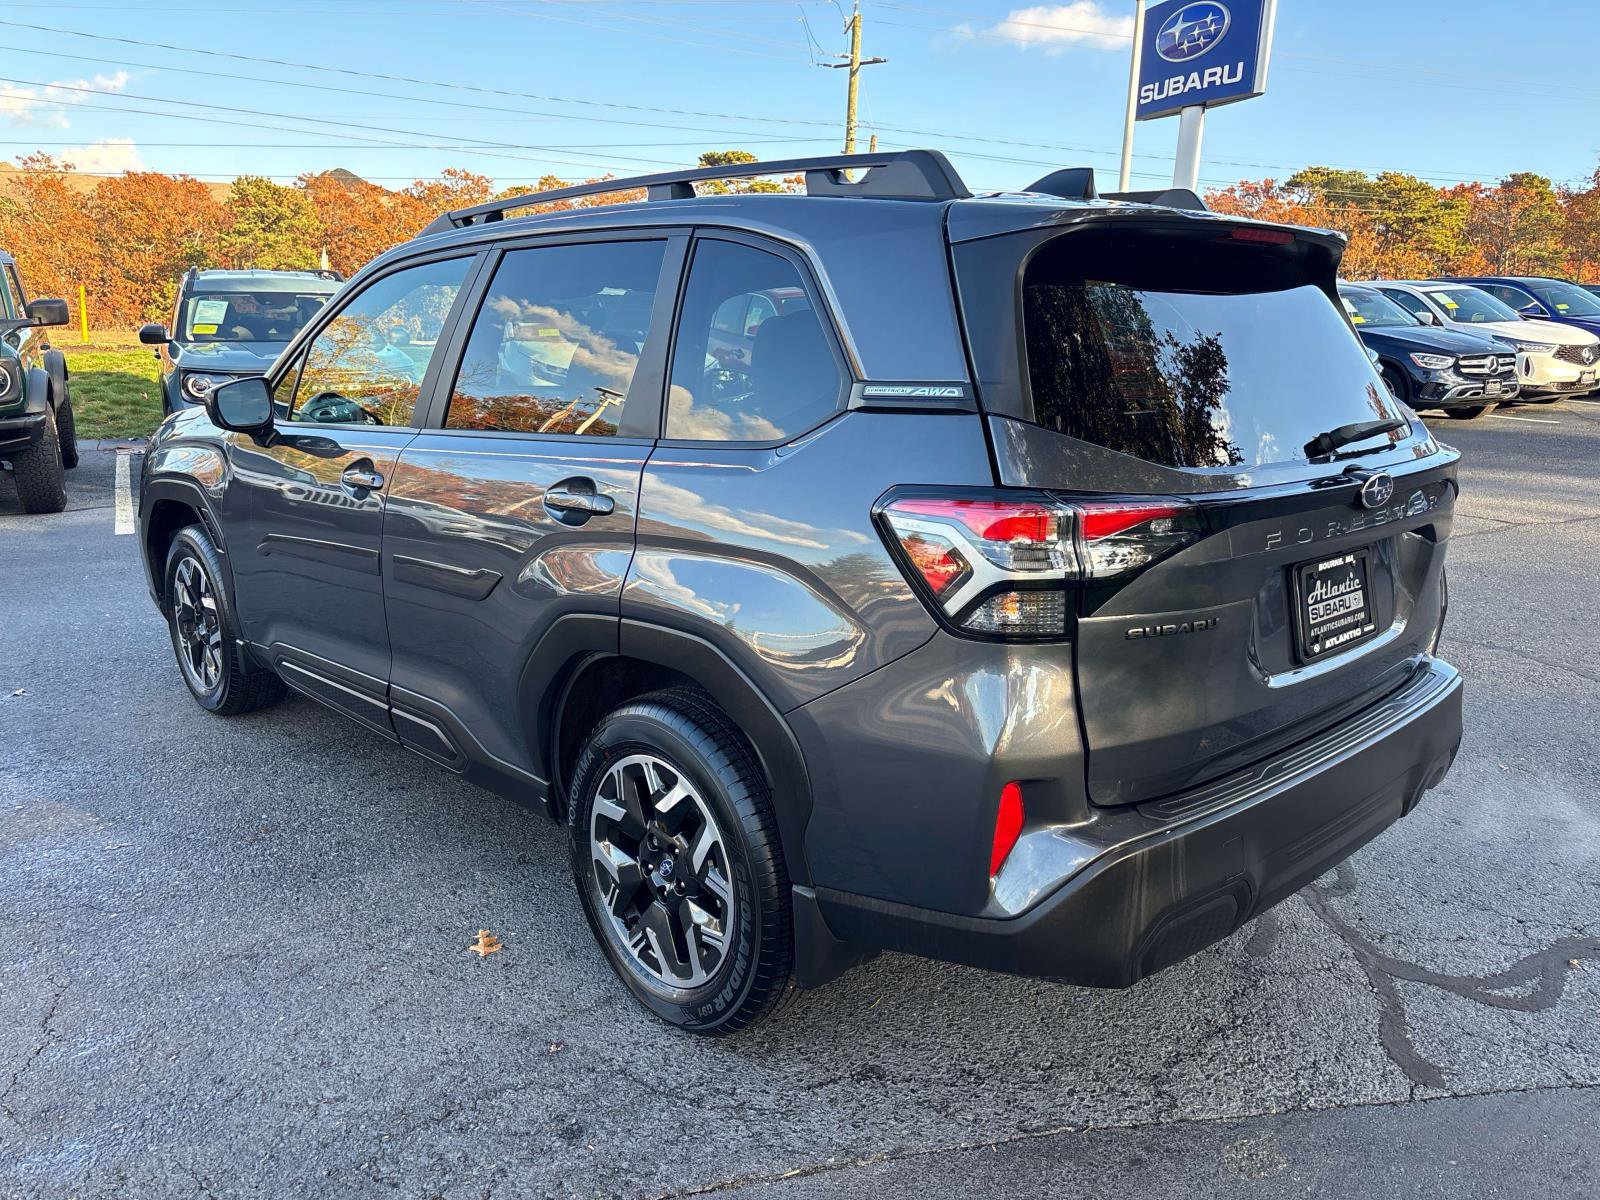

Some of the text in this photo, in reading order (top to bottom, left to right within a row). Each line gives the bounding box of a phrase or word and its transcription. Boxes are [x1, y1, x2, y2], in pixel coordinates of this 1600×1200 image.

[1139, 61, 1244, 105] SUBARU
[911, 386, 960, 396] AWD
[1308, 573, 1362, 604] Atlantic
[1311, 597, 1352, 620] SUBARU
[1124, 617, 1220, 639] SUBARU
[1311, 611, 1365, 637] ATLANTICSUBARU.COM
[1325, 627, 1362, 649] ATLANTIC
[568, 748, 596, 827] YOKOHAMA
[712, 862, 751, 1012] GEOLANDAR
